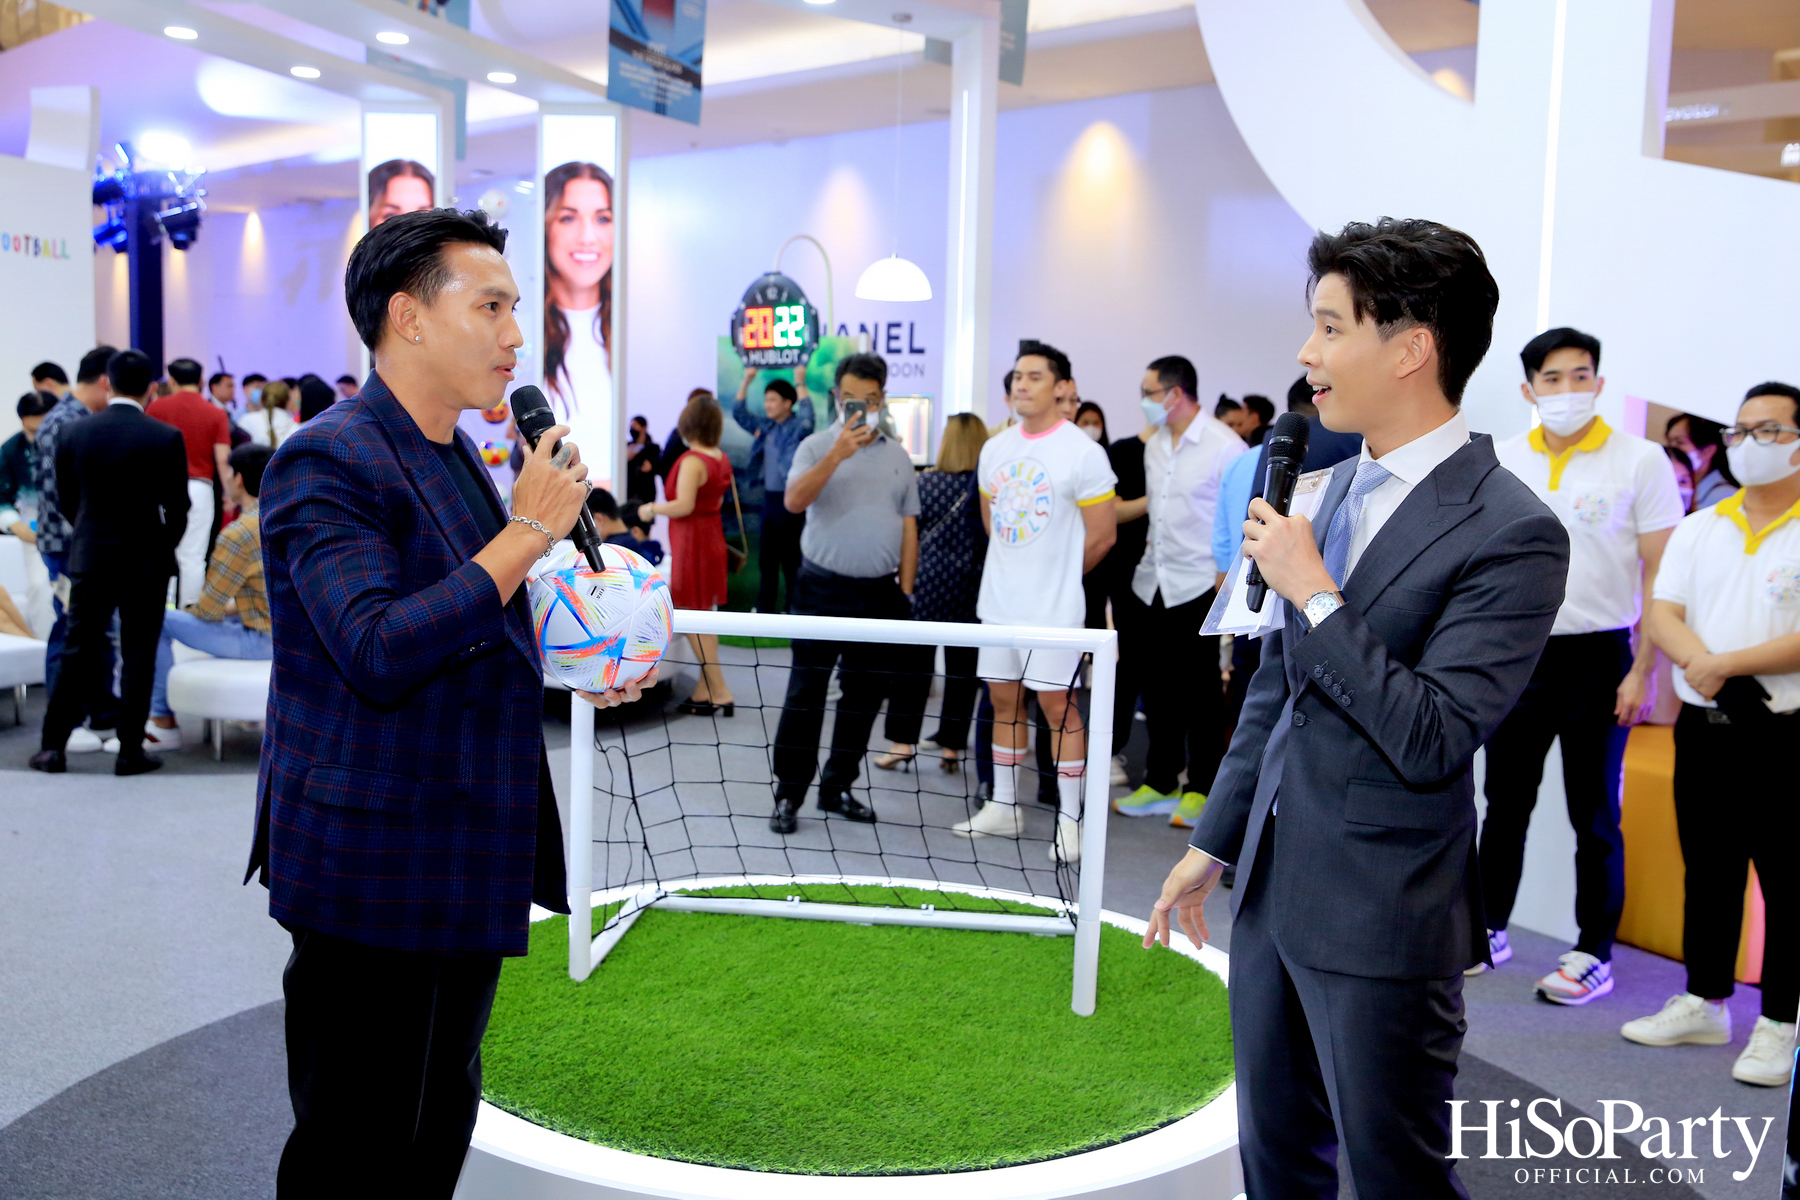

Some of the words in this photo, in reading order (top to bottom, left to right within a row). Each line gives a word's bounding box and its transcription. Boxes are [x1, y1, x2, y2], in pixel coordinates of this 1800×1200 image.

[1, 232, 71, 260] OOTBALL
[749, 350, 800, 365] HUBLOT
[887, 362, 926, 378] OON
